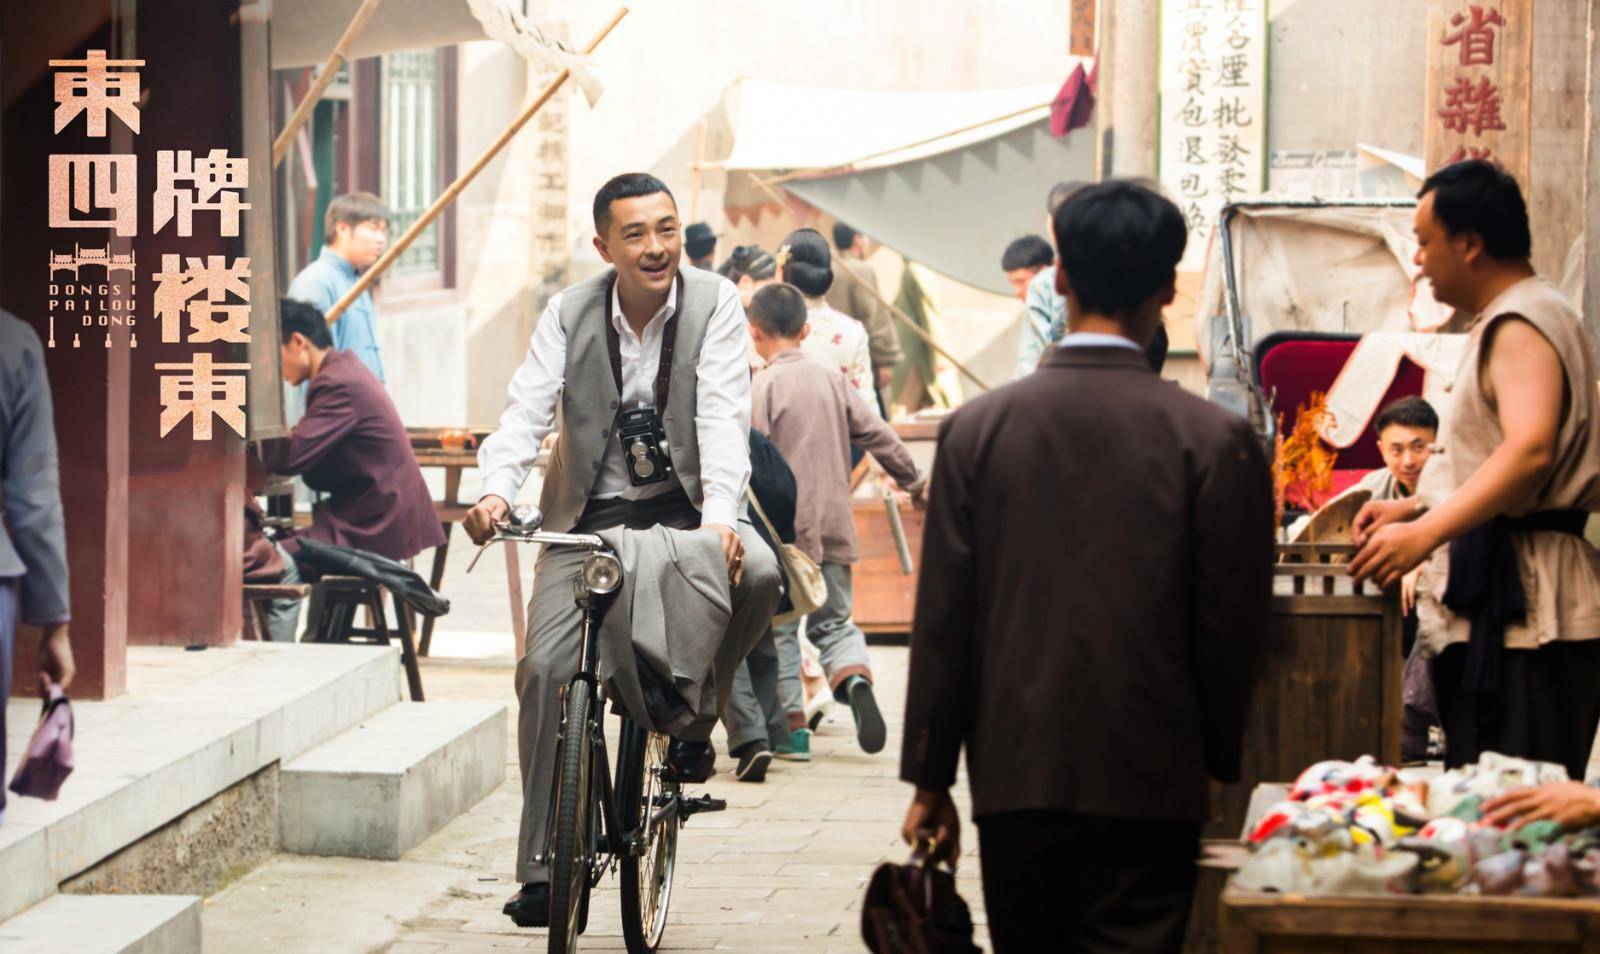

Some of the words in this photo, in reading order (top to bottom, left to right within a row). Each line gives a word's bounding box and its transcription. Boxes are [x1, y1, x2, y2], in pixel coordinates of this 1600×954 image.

[1213, 0, 1252, 206] 名煙批發零
